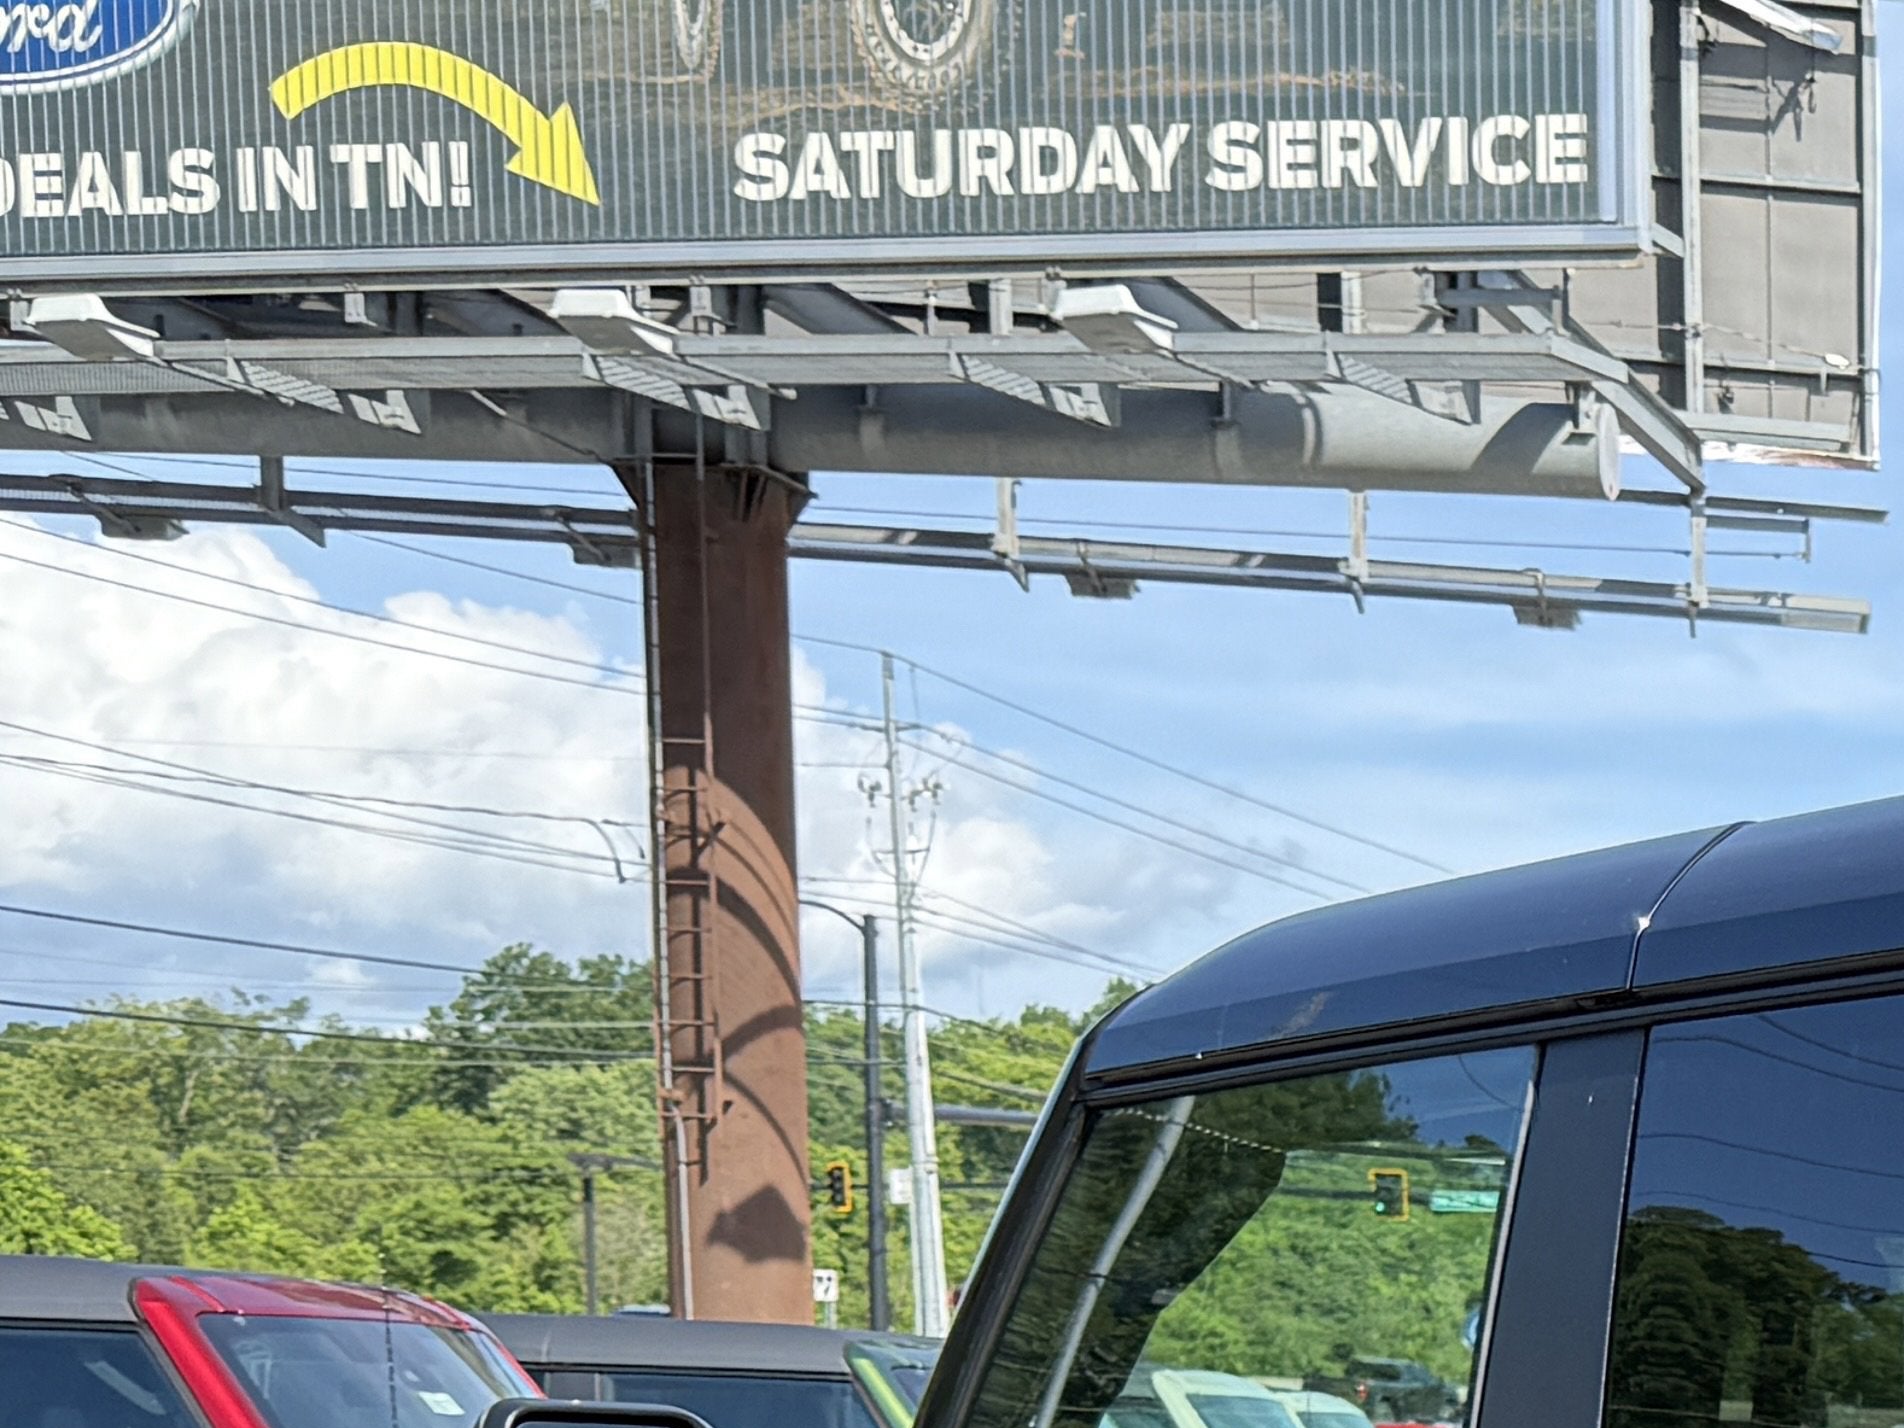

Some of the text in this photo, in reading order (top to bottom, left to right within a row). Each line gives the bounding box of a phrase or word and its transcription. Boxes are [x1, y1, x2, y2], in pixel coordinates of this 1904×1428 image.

[237, 145, 316, 212] IN
[330, 141, 471, 209] TN!
[734, 112, 1588, 201] SATURDAY SERVICE
